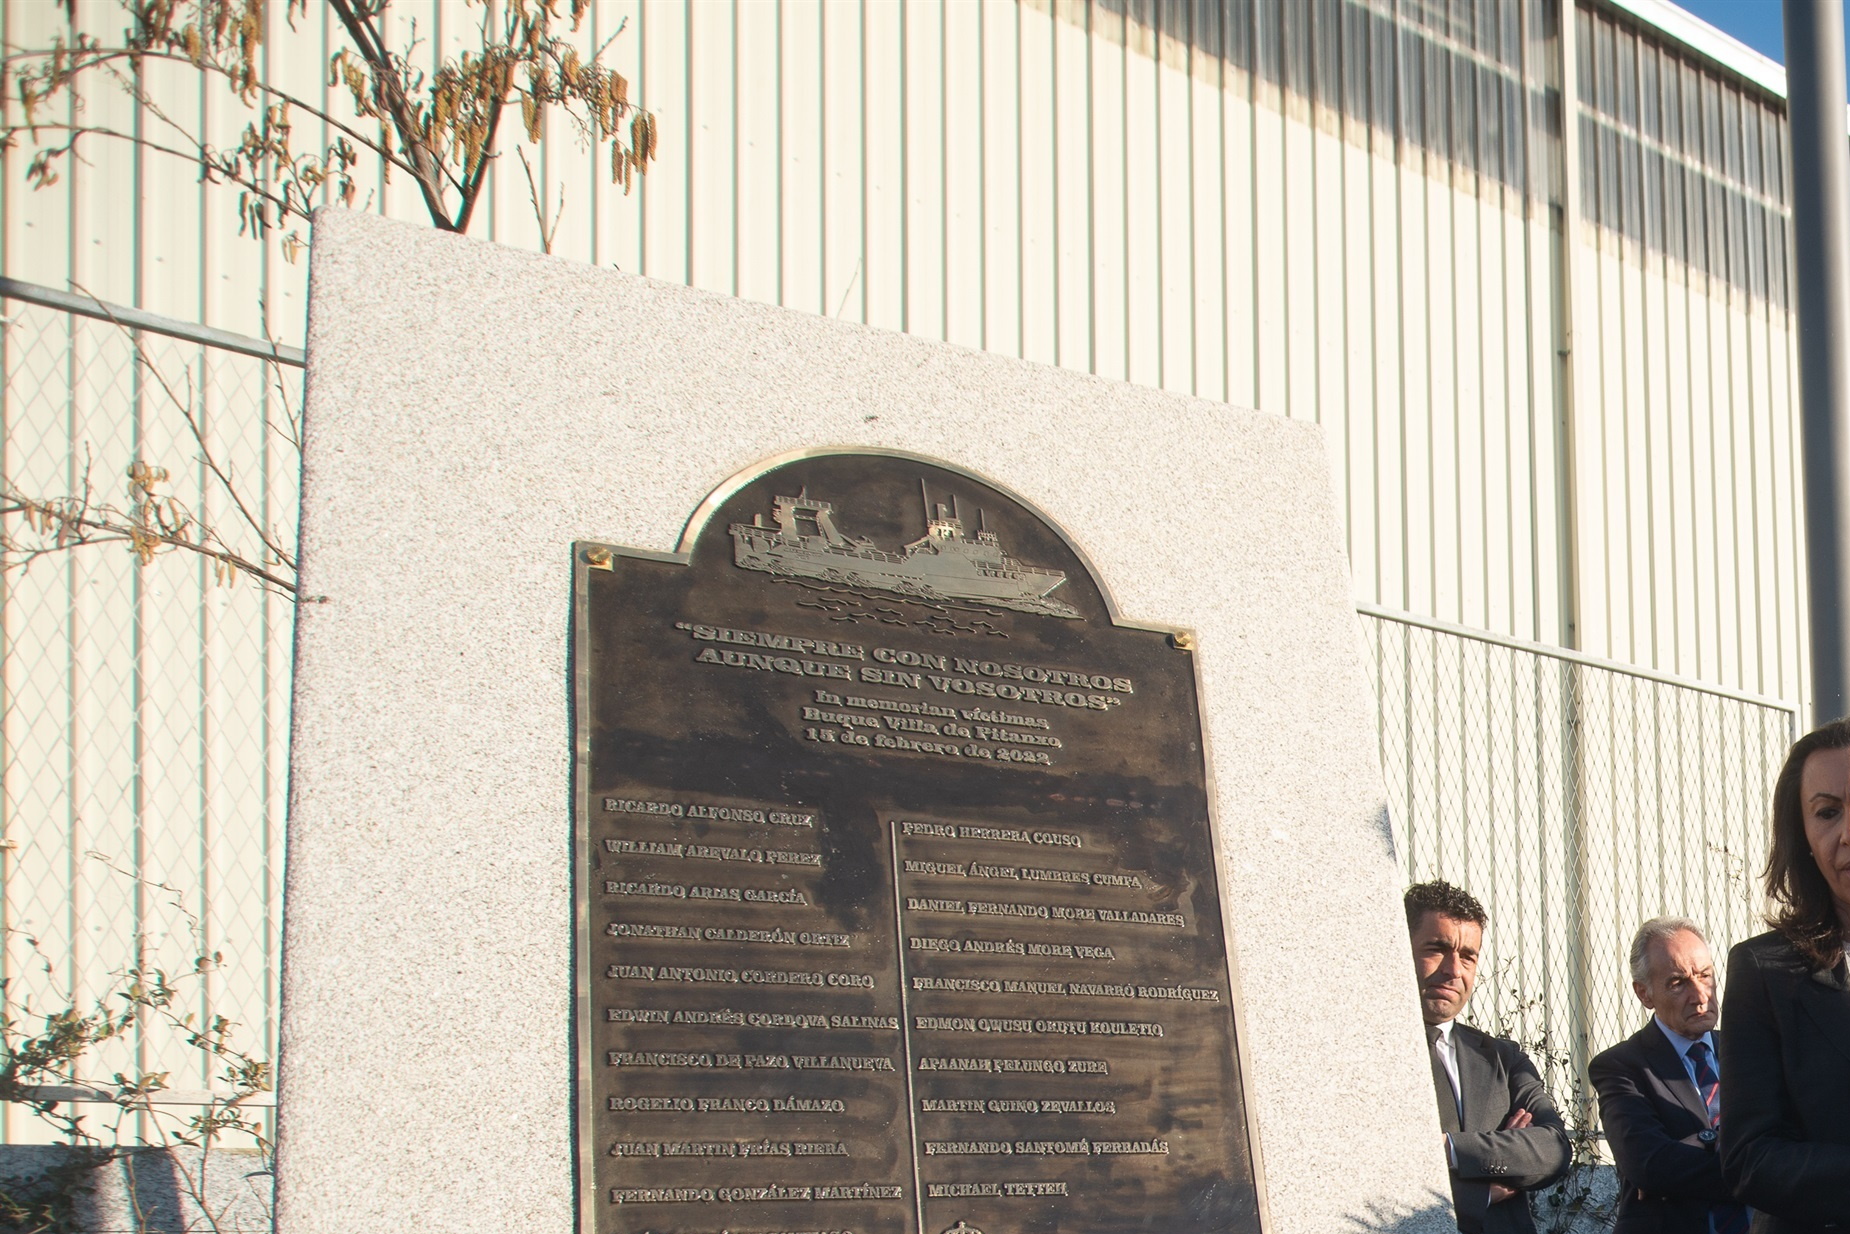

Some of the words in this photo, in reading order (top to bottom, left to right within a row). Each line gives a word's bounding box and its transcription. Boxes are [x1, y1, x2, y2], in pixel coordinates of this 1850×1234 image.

[696, 647, 852, 681] AUNQUE
[861, 667, 921, 690] SIN
[873, 647, 946, 671] CON
[955, 658, 1133, 694] NOSOTROS
[814, 689, 842, 707] In
[846, 695, 955, 719] memorian
[961, 707, 1050, 730] víctimas
[802, 706, 879, 730] Buque
[884, 715, 936, 735] Villa
[944, 721, 971, 739] de
[975, 725, 1062, 749] Pitanxo
[806, 727, 834, 743] 15
[840, 731, 869, 746] de
[874, 733, 959, 755] febrero
[964, 742, 990, 758] de
[996, 746, 1051, 766] 2022
[605, 798, 684, 817] RICARDO
[687, 805, 766, 824] ALFONSO
[769, 812, 813, 828] CRUZ
[902, 821, 957, 838] PEDRO
[959, 826, 1031, 844] HERRERA
[1032, 832, 1082, 848] COUSO
[605, 840, 682, 857] WILLIAM
[904, 860, 966, 877] MIGUEL
[968, 862, 1019, 880] ÁNGEL
[606, 881, 686, 899] RICARDO
[689, 885, 740, 902] ARIAS
[743, 888, 808, 906] GARCÍA
[907, 897, 965, 914] DANIEL
[967, 902, 1049, 920] FERNANDO
[1051, 906, 1096, 922] MORE
[1098, 909, 1185, 928] VALLADARES
[607, 923, 701, 940] JONATHAN
[704, 927, 796, 945] CALDERÓN
[799, 933, 850, 947] ORTIZ
[910, 937, 961, 953] DIEGO
[963, 939, 1025, 957] ANDRÉS
[1028, 944, 1074, 958] MORE
[1075, 946, 1116, 960] VEGA
[608, 965, 654, 981] JUAN
[657, 967, 738, 984] ANTONIO
[740, 969, 825, 986] CORDERO
[827, 974, 875, 989] CORO
[913, 977, 1001, 993] FRANCISCO
[1004, 980, 1067, 997] MANUEL
[1137, 985, 1220, 1002] RODRÍGUEZ
[608, 1009, 669, 1024] EDWIN
[673, 1008, 745, 1025] ANDRÉS
[831, 1015, 900, 1030] SALINAS
[608, 1051, 712, 1068] FRANCISCO
[715, 1053, 741, 1068] DE
[744, 1054, 790, 1069] PAZO
[792, 1055, 896, 1072] VILLANUEVA
[609, 1097, 694, 1112] ROGELIO
[698, 1098, 770, 1113] FRANCO
[921, 1099, 986, 1114] MARTIN
[988, 1100, 1039, 1114] QUINO
[611, 1142, 660, 1158] JUAN
[663, 1142, 737, 1157] MARTIN
[739, 1138, 792, 1158] FRÍAS
[794, 1143, 850, 1157] RIERA
[924, 1141, 1013, 1156] FERNANDO
[612, 1188, 714, 1204] FERNANDO
[718, 1183, 811, 1201] GONZÁLEZ
[814, 1182, 903, 1200] MARTÍNEZ
[928, 1182, 1002, 1198] MICHAEL
